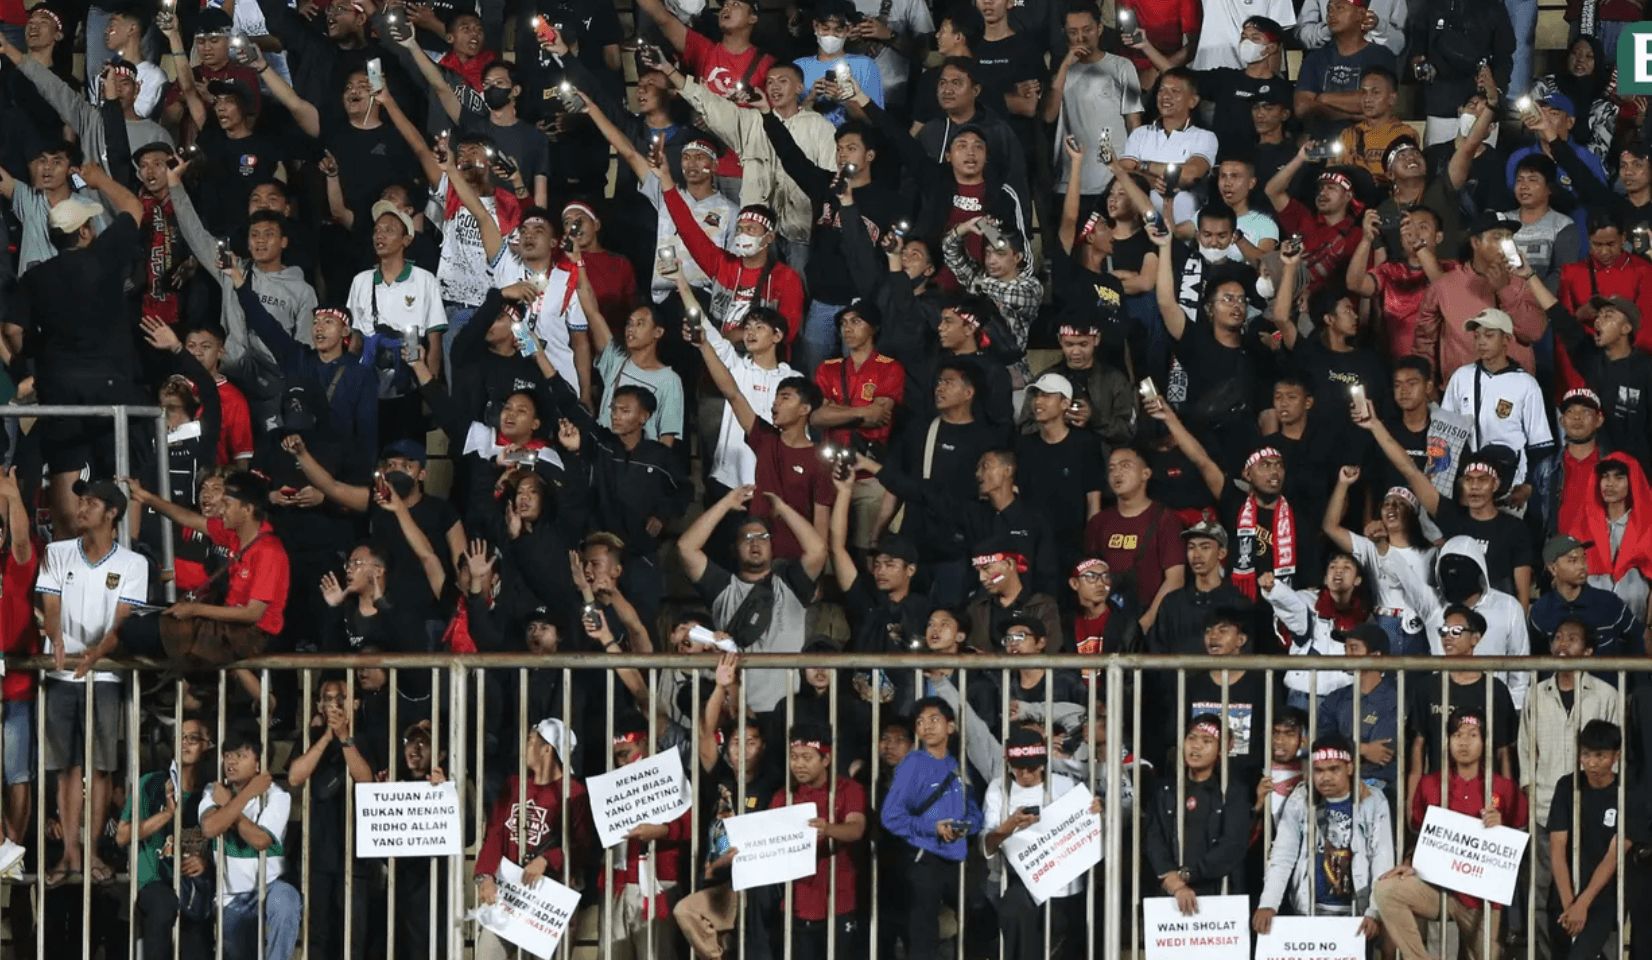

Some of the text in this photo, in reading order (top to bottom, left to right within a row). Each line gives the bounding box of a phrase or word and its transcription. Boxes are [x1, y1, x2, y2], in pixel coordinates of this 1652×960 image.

[615, 766, 660, 788] MENANG
[373, 791, 445, 802] TUJUAN AFF
[605, 775, 674, 805] KALAH BIASA
[362, 806, 455, 817] BUKAN MENANG
[604, 786, 679, 819] YANG PENTING
[608, 798, 684, 832] AKHLAK MULIA
[370, 821, 448, 832] RIDHO ALLAH
[372, 836, 447, 847] YANG UTAMA
[744, 831, 804, 849] WANI MENANG
[787, 841, 812, 854] ALLAH
[1017, 842, 1038, 861] Bola
[1037, 832, 1052, 846] itu
[1421, 836, 1480, 862] TINGGALKAN
[1424, 822, 1518, 859] MENANG BOLEH
[1024, 848, 1050, 870] kayak
[1451, 858, 1486, 878] NO!!!
[1032, 859, 1055, 882] gada
[540, 901, 568, 919] LELAH
[1157, 920, 1237, 932] WANI SHOLAT
[1155, 936, 1240, 947] WEDI MAKSIAT
[1283, 942, 1337, 951] SLOD NO
